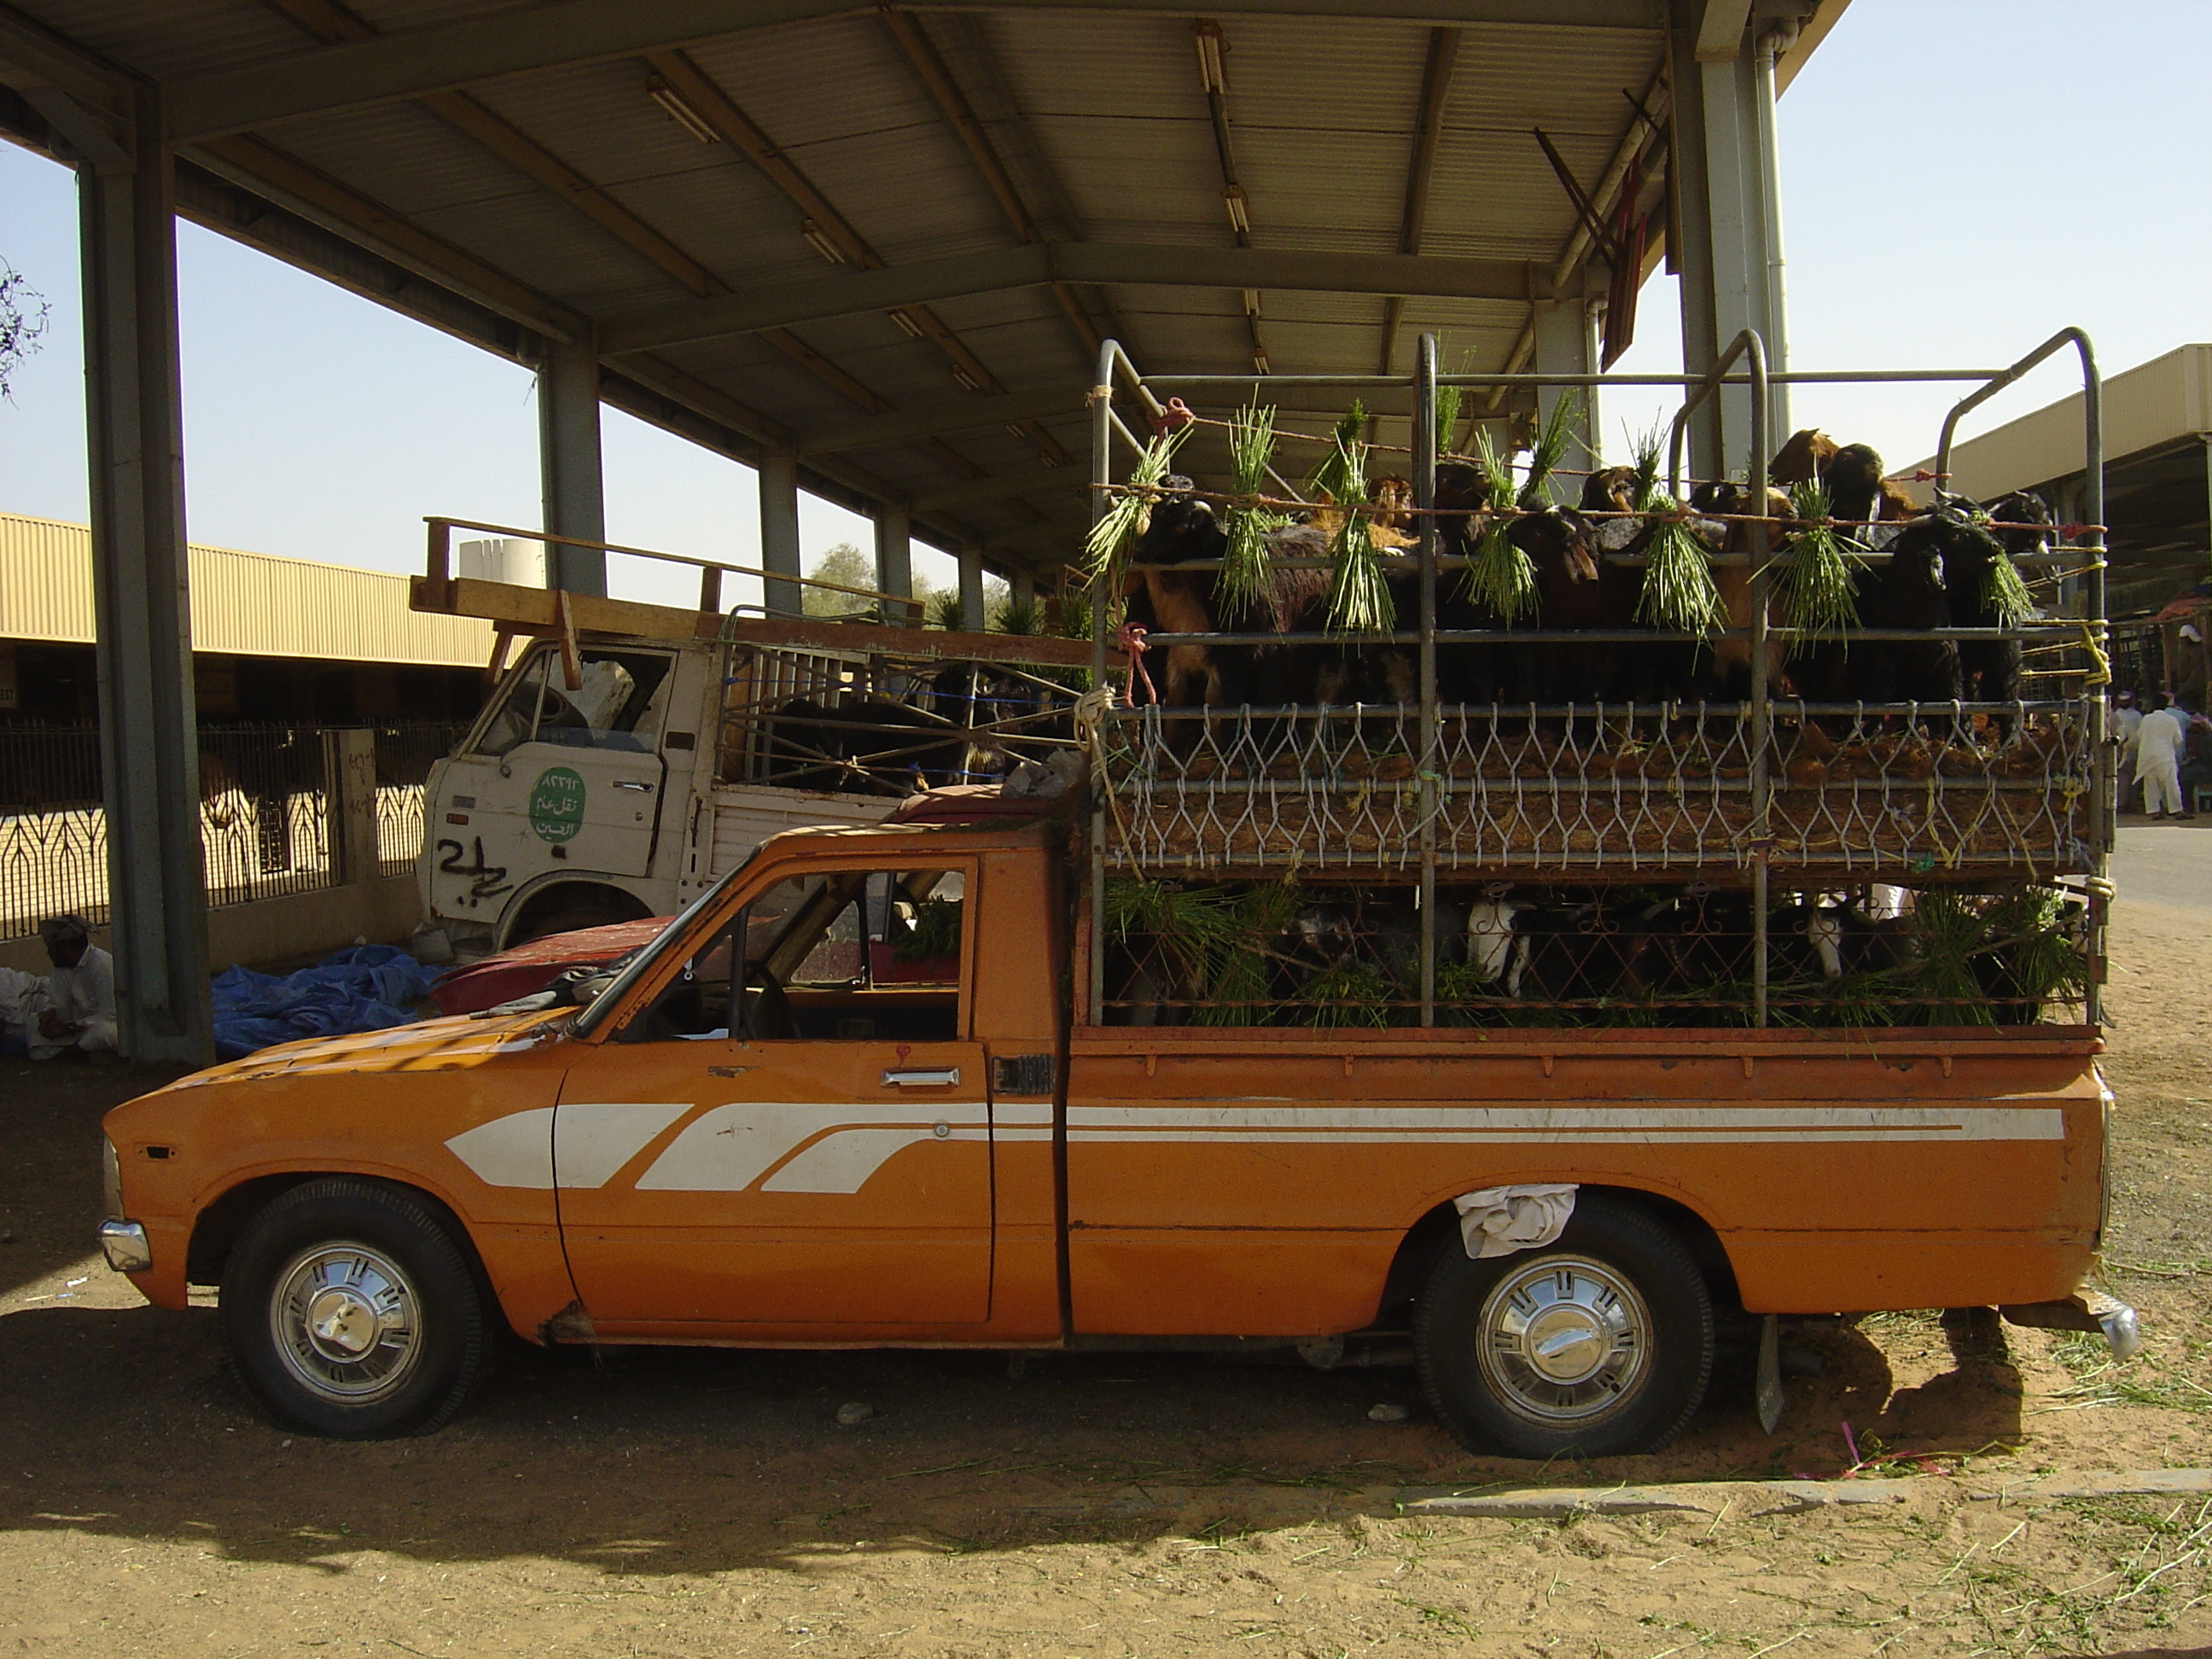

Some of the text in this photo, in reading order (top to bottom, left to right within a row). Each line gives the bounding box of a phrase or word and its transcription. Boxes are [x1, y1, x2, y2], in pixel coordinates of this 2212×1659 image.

[535, 795, 578, 817] نقل عام
[536, 822, 574, 841] العين
